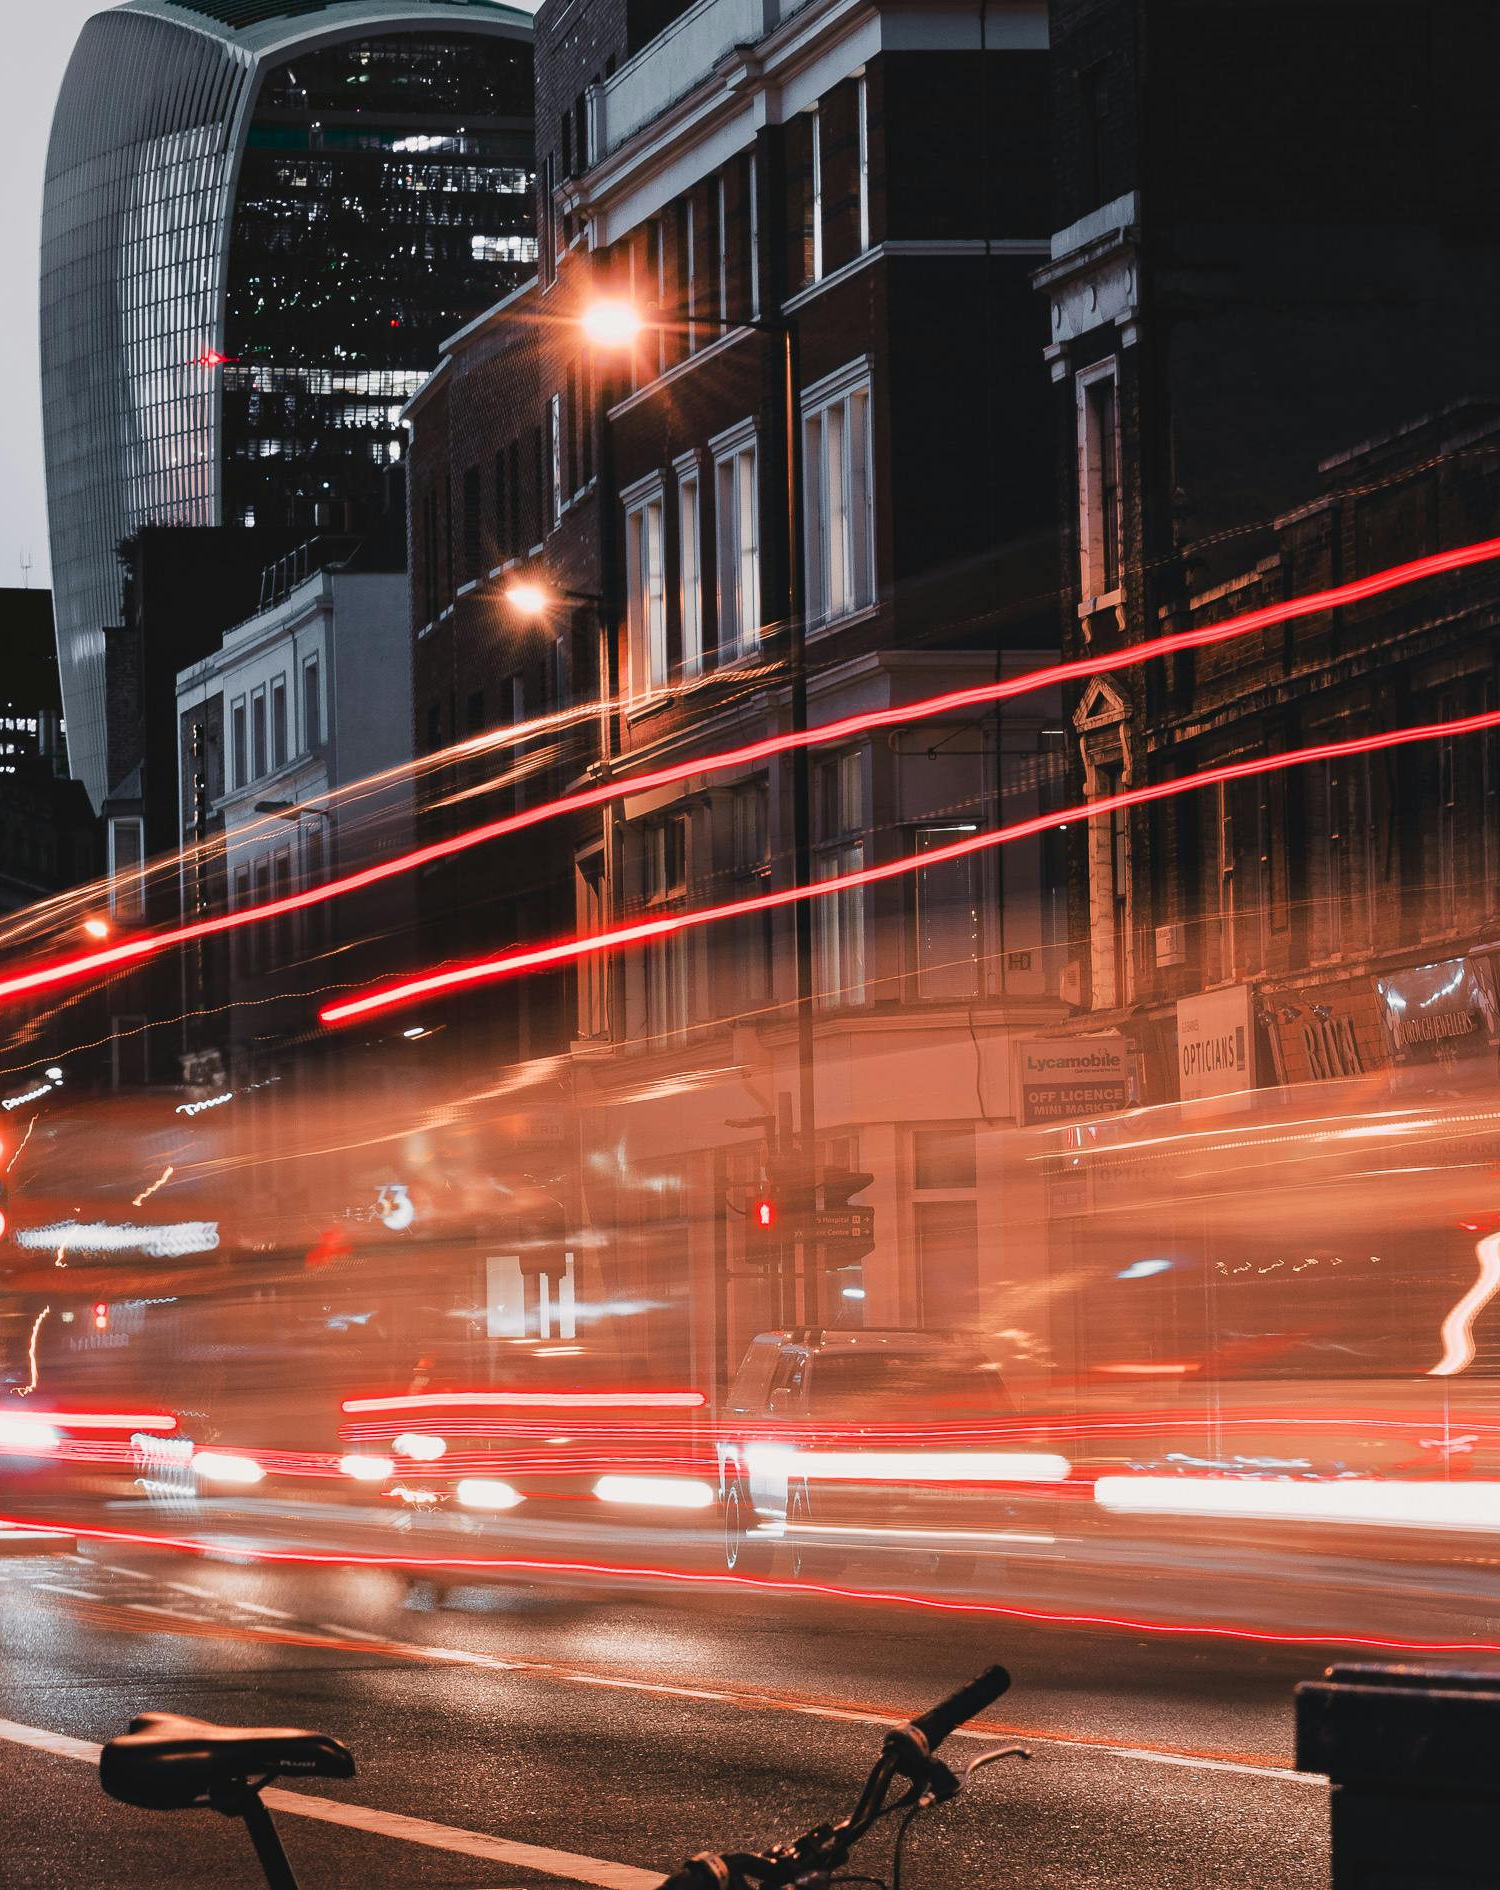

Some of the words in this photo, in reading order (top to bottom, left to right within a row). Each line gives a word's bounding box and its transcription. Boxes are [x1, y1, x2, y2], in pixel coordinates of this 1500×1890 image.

[1027, 1053, 1122, 1072] Lycamobile
[1183, 1035, 1235, 1077] OPTICIANS
[1028, 1091, 1057, 1104] OFF
[1059, 1088, 1124, 1102] LICENCE
[1034, 1105, 1062, 1116] MINI
[1066, 1103, 1120, 1114] MARKET
